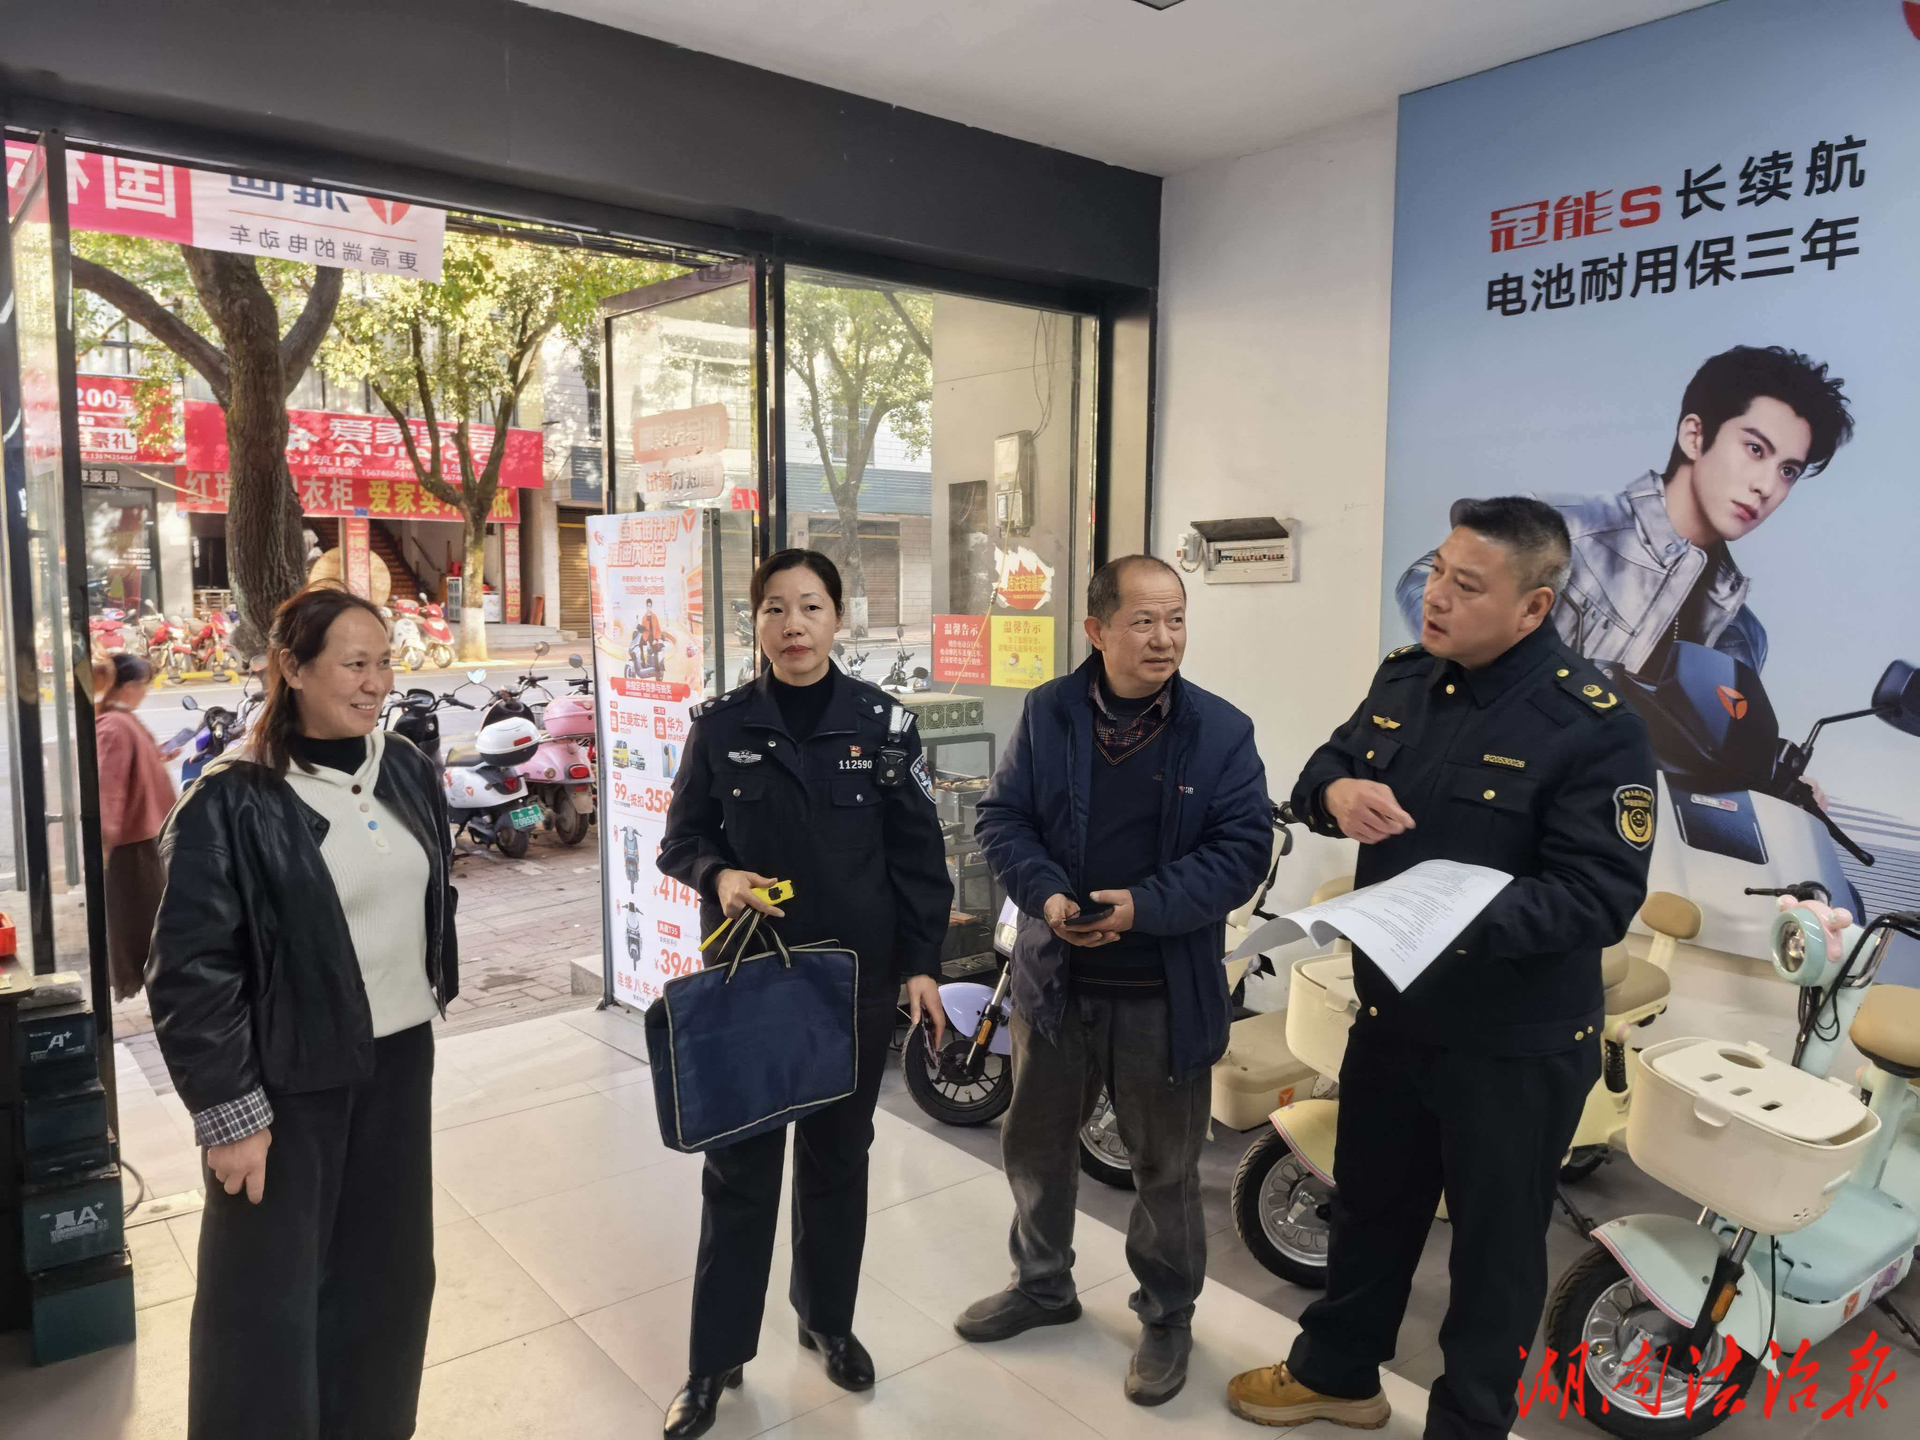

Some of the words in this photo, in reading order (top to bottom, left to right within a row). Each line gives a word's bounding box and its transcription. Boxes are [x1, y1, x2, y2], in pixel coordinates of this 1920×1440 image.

[1490, 184, 1663, 253] 冠能S
[1675, 135, 1867, 220] 长续航
[1486, 216, 1860, 317] 电池耐用保三年
[944, 622, 978, 636] 温馨告示
[1003, 620, 1041, 635] 温馨告示
[619, 711, 649, 728] 五菱宏光
[667, 716, 684, 733] 华为
[839, 759, 873, 770] 112590
[614, 782, 627, 801] 99
